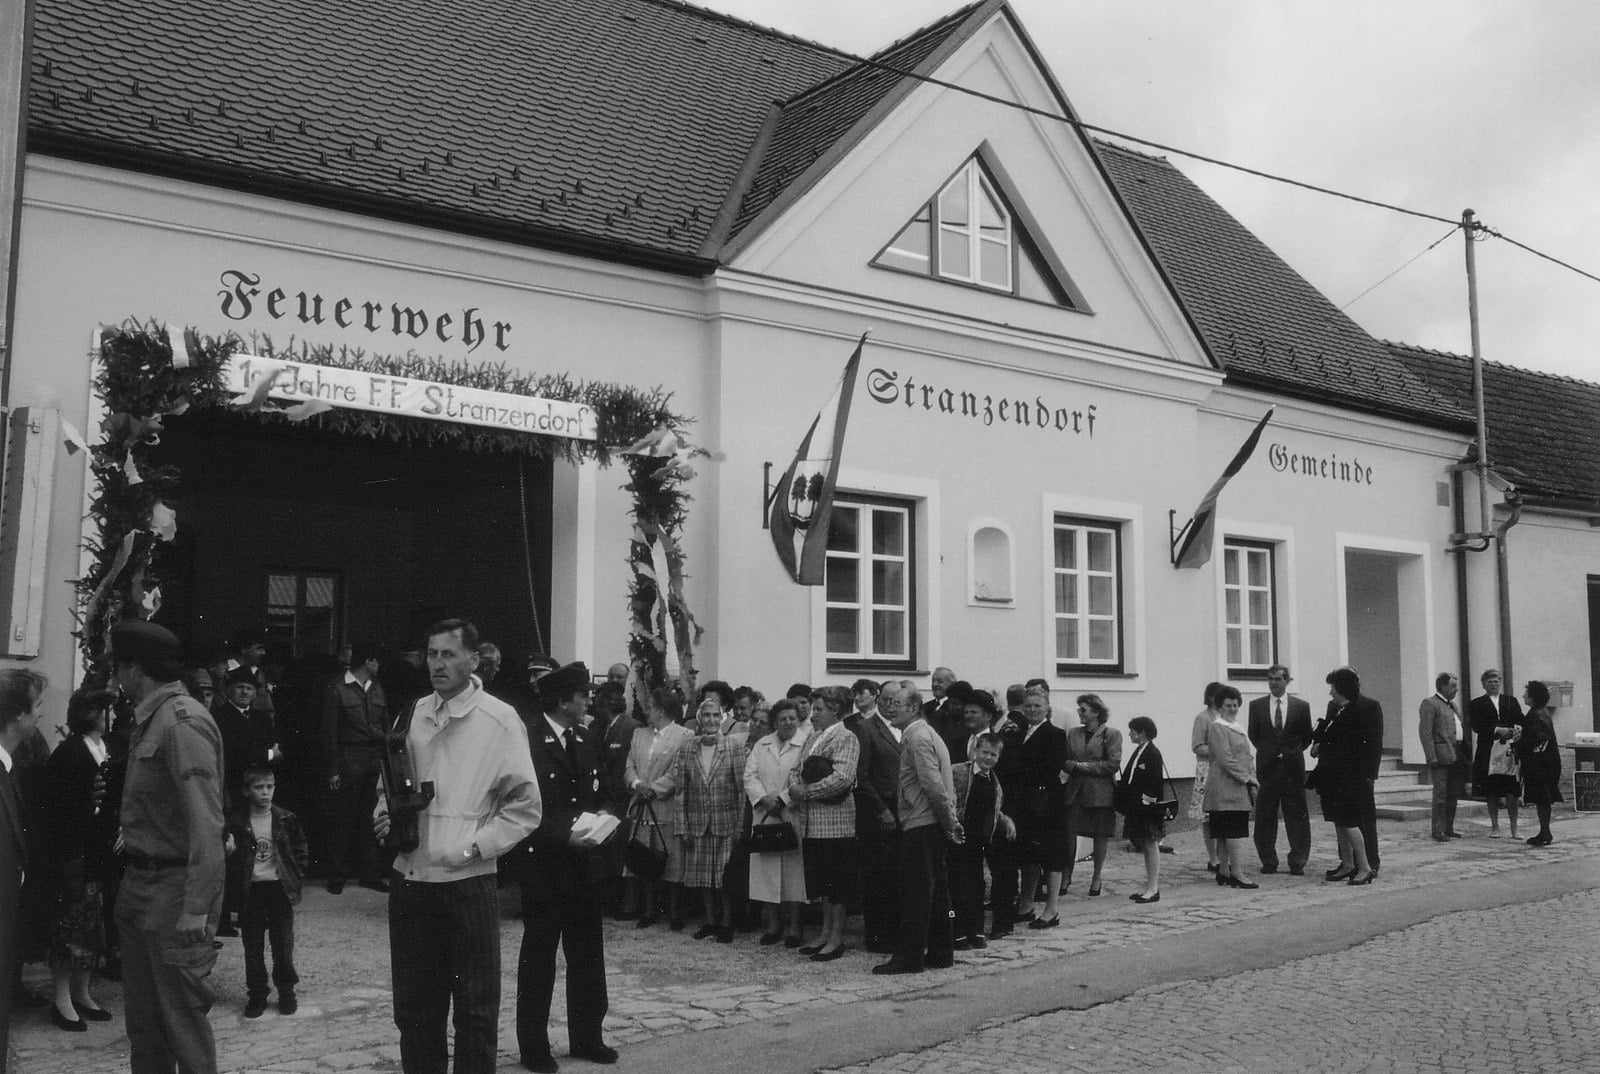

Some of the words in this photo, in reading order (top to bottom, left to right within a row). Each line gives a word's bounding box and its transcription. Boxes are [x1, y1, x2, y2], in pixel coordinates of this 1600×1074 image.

[217, 269, 512, 353] Feuerwehr
[279, 365, 357, 402] Jahre
[420, 385, 590, 437] Stranzendorf
[866, 368, 1097, 439] Stranzendorf
[1269, 443, 1373, 485] Gemeinde
